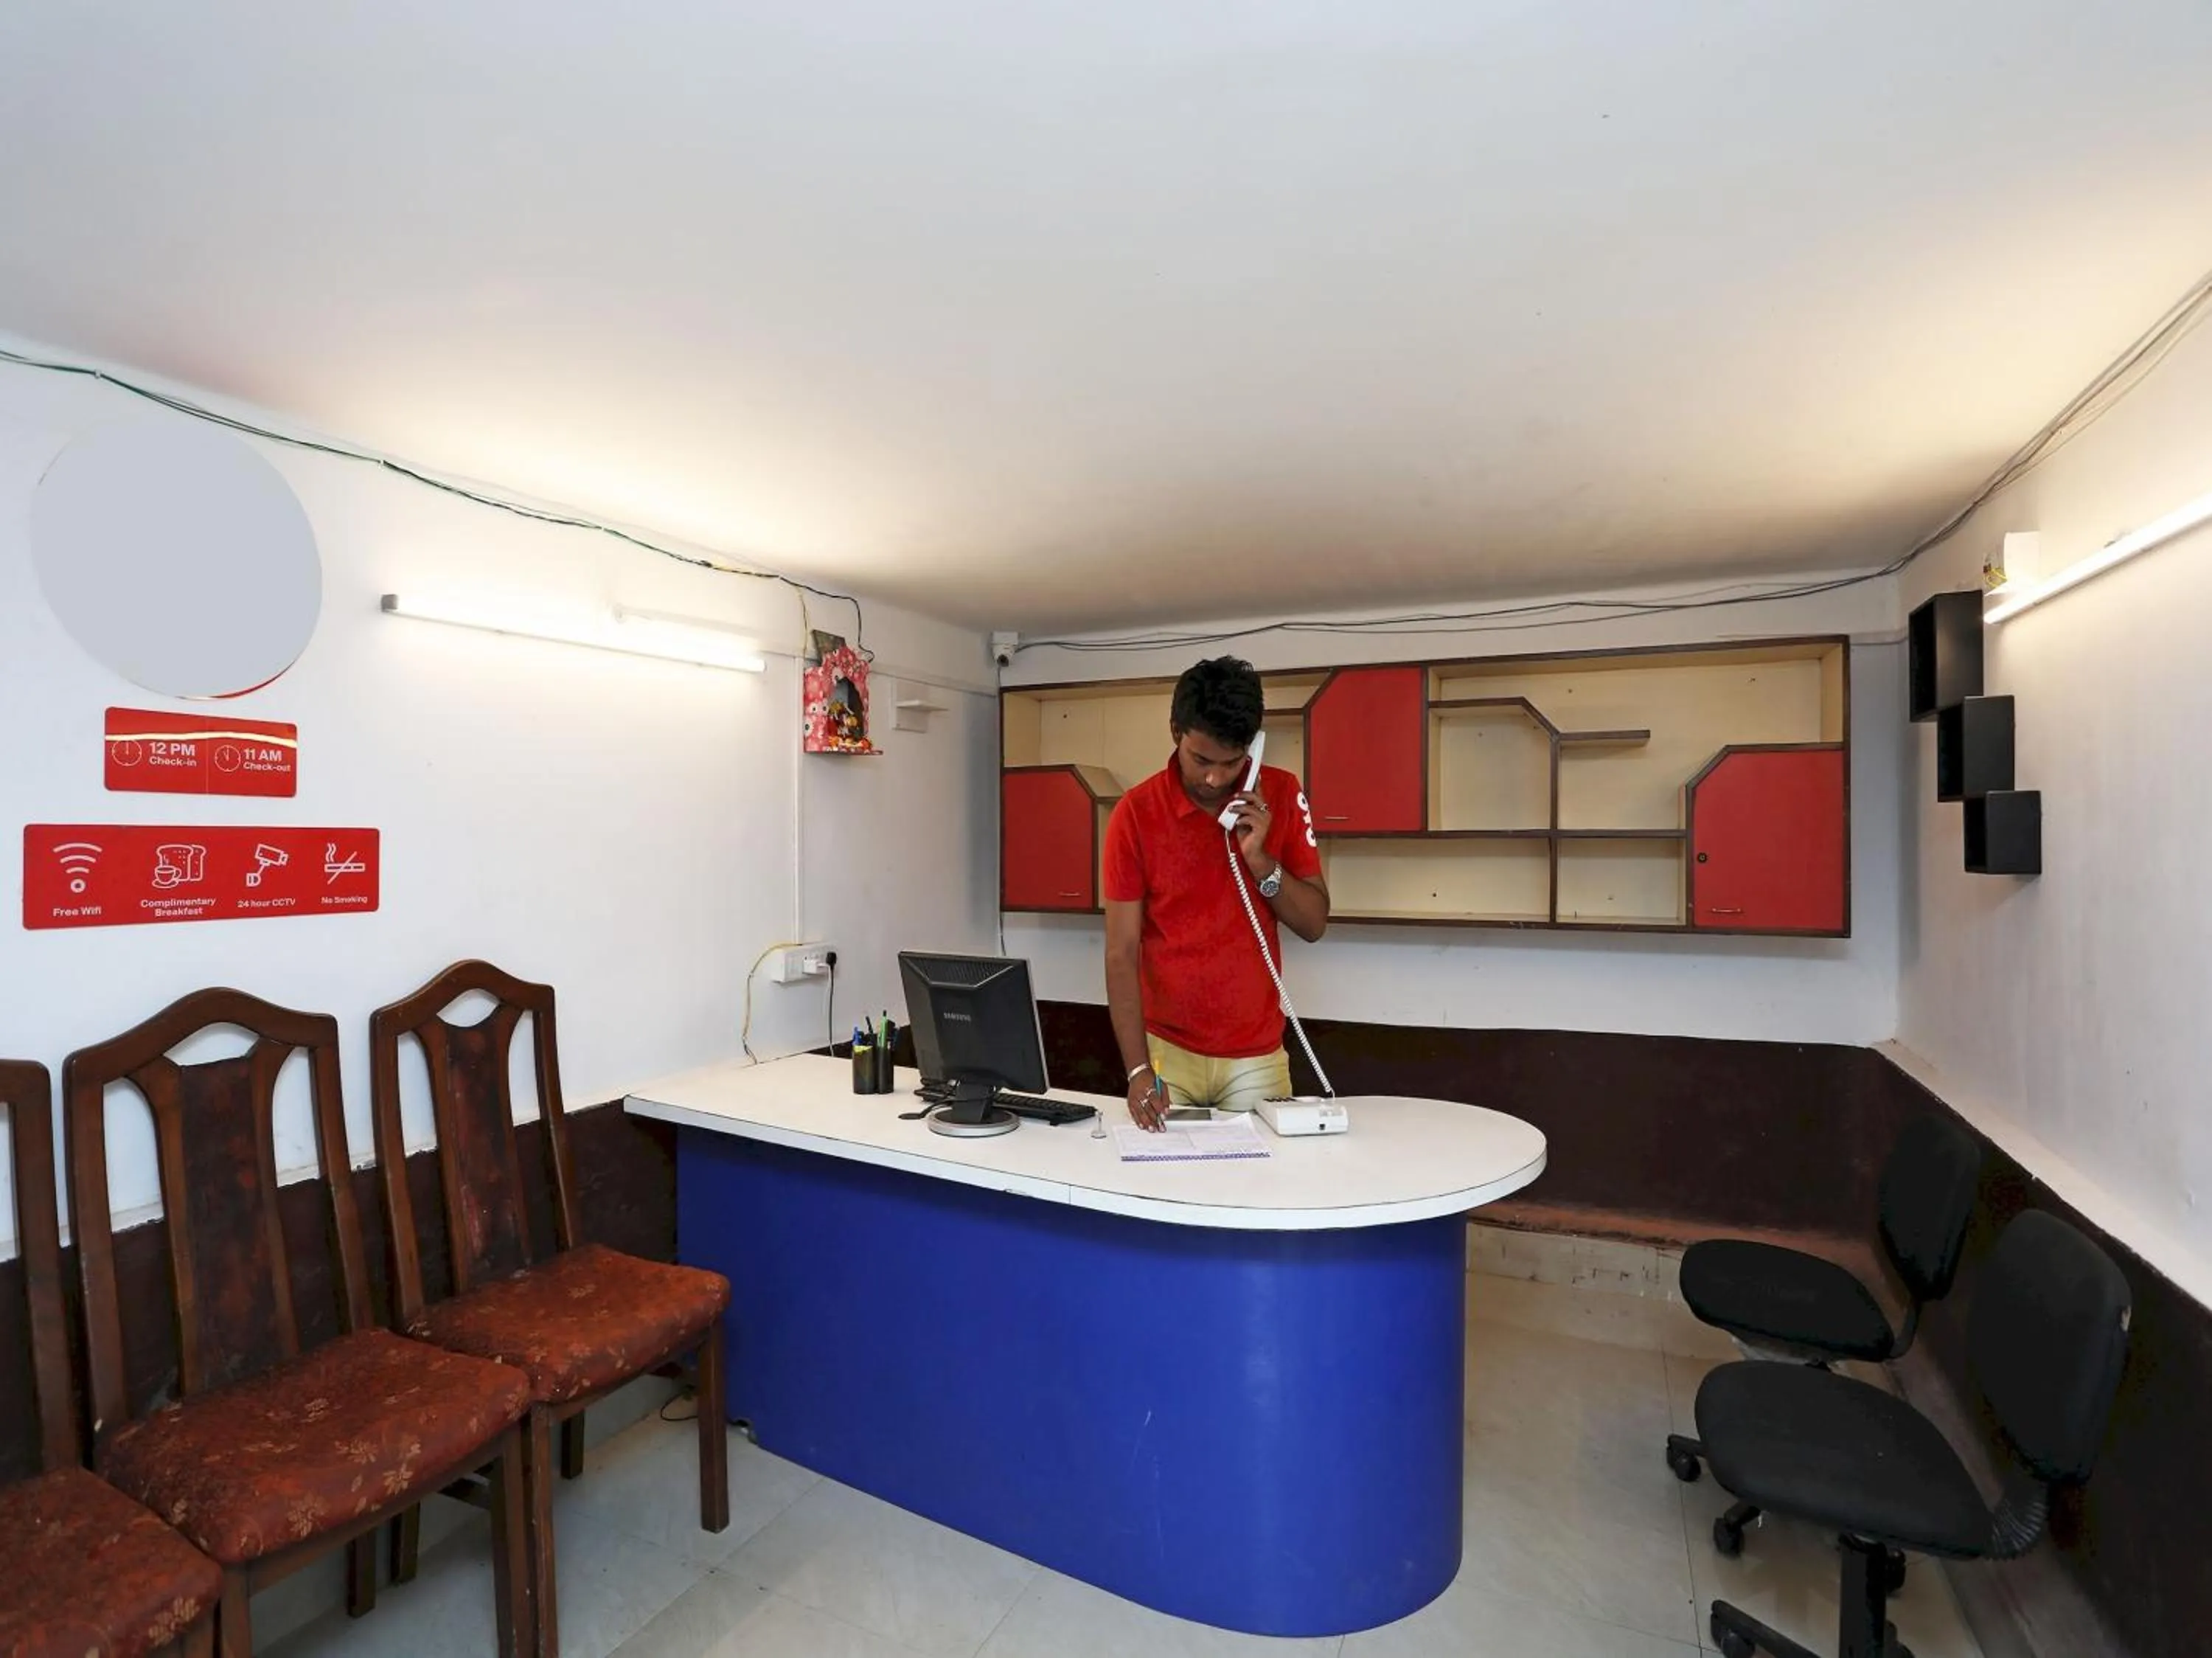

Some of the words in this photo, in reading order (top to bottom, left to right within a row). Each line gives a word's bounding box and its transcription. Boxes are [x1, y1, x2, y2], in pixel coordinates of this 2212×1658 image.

[150, 742, 167, 755] 12
[170, 743, 195, 757] PM
[243, 749, 254, 760] 11
[259, 749, 282, 761] AM
[149, 755, 197, 767] Check-in
[243, 762, 291, 772] Check-out
[140, 898, 216, 908] Complimentary
[237, 900, 249, 908] 24
[251, 898, 271, 908] hour
[271, 898, 296, 907] CCTV
[321, 896, 333, 904] No
[334, 895, 368, 904] Smoking
[52, 907, 79, 917] Free
[80, 906, 102, 915] Wifi
[154, 906, 204, 918] Breakfast
